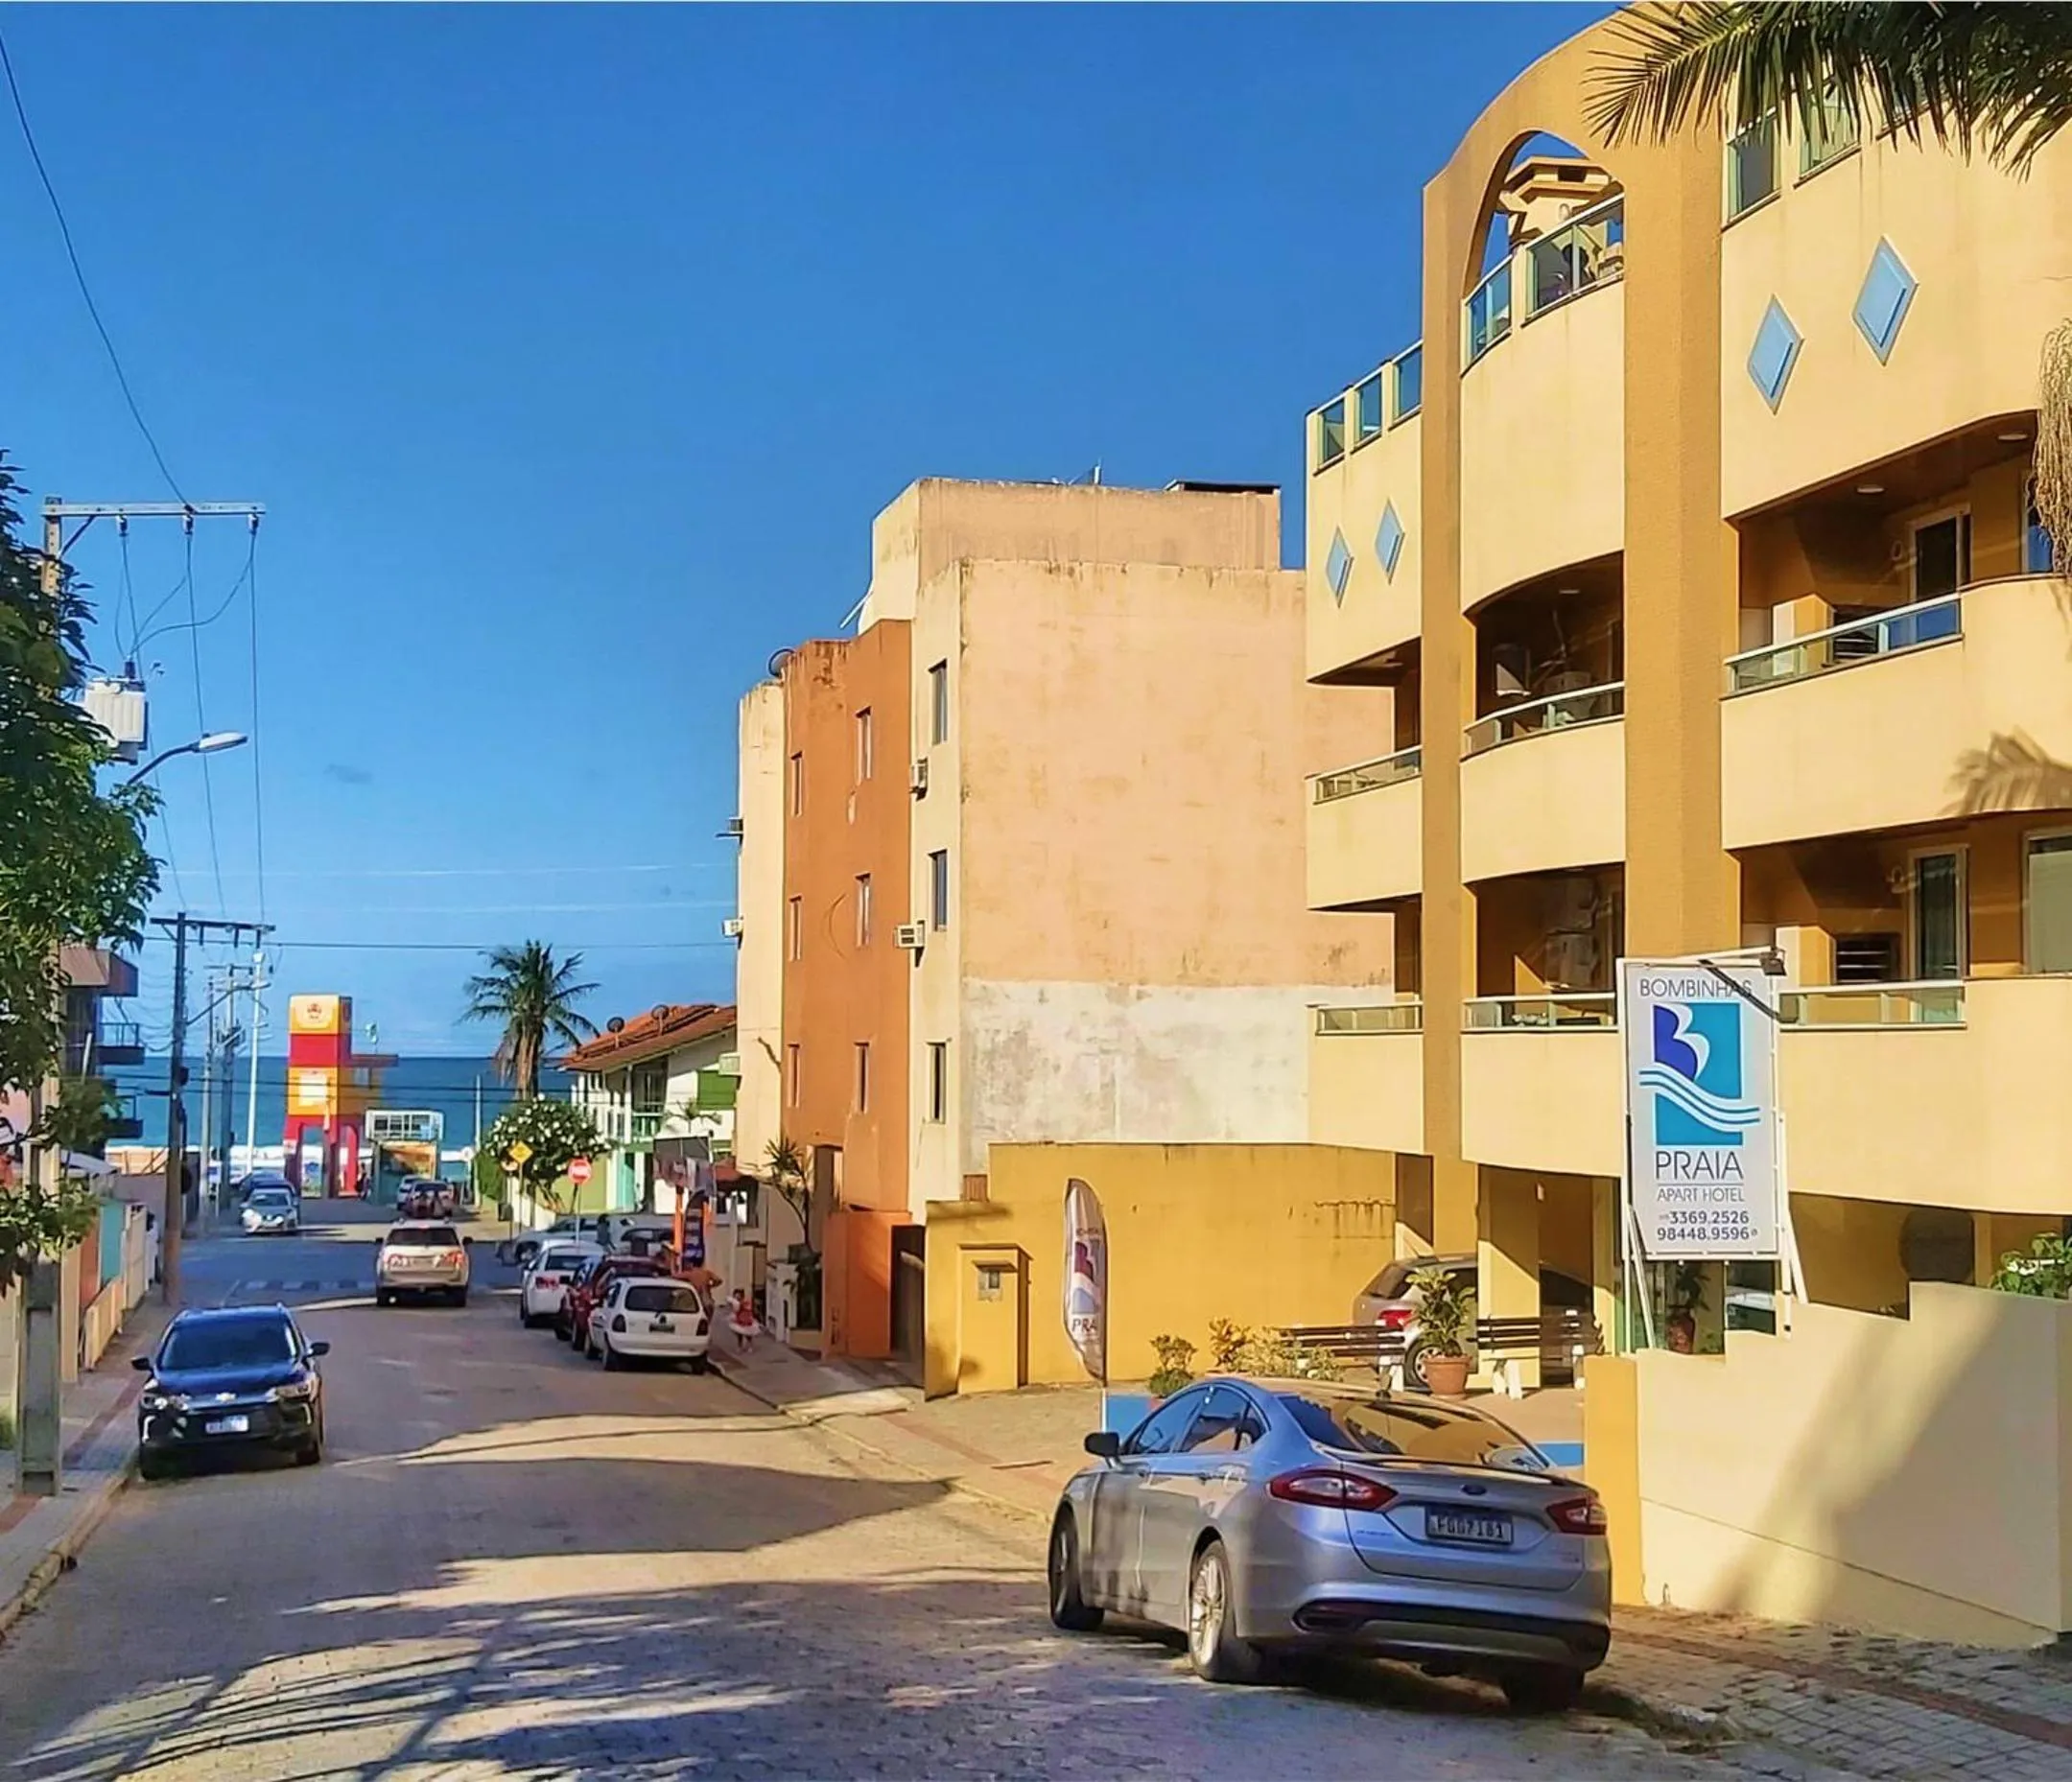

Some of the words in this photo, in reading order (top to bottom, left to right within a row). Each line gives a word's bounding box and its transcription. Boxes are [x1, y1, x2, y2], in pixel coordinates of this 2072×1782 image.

[1655, 1150, 1744, 1181] PRAIA
[1657, 1187, 1698, 1203] APART
[1703, 1187, 1745, 1203] HOTEL
[1669, 1209, 1750, 1225] 3369.2526
[1657, 1227, 1750, 1241] 98448.9596
